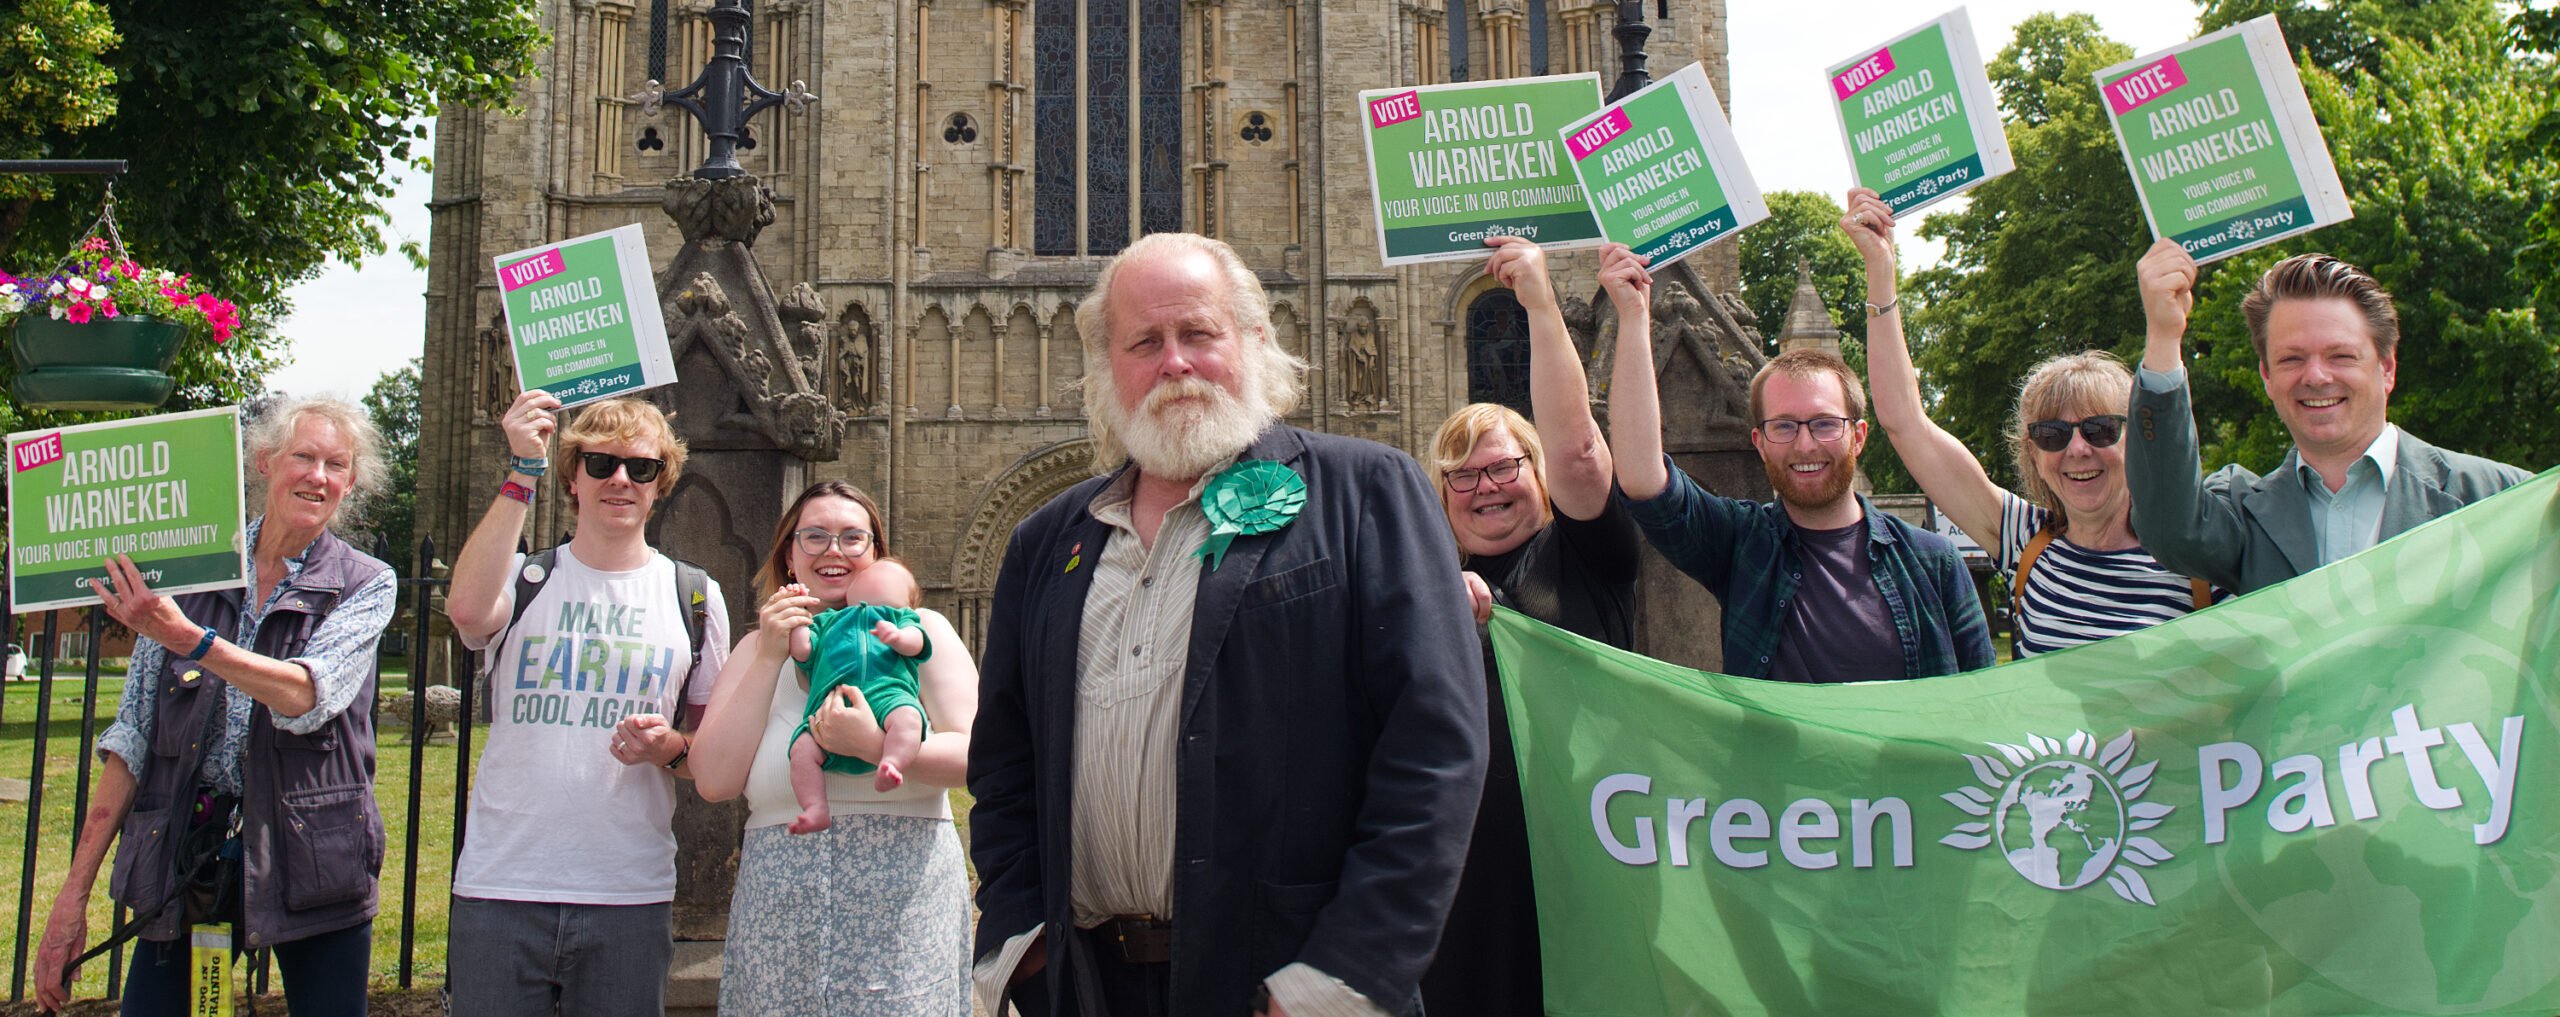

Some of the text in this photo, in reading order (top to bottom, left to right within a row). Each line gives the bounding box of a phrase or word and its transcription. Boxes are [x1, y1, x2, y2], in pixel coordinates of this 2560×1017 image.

[1841, 56, 1885, 92] VOTE
[2116, 65, 2172, 106] VOTE
[1373, 95, 1418, 123] VOTE
[1863, 69, 1934, 119] ARNOLD
[1423, 102, 1534, 144] ARNOLD
[1854, 92, 1958, 155] WARNEKEN
[2148, 87, 2240, 141] ARNOLD
[1575, 115, 1620, 153] VOTE
[1601, 125, 1675, 177] ARNOLD
[1884, 133, 1942, 166] YOUR VOICE IN
[2140, 118, 2274, 184] WARNEKEN
[1409, 139, 1558, 189] WARNEKEN
[1597, 147, 1702, 212] WARNEKEN
[1884, 146, 1950, 184] OUR COMMUNITY
[1937, 165, 1969, 187] Party
[1383, 183, 1582, 219] YOUR VOICE IN OUR COMMUNIT
[2182, 167, 2256, 200] YOUR VOICE IN
[1632, 187, 1690, 222] YOUR VOICE IN
[1633, 200, 1700, 239] OUR COMMUNITY
[2184, 184, 2269, 222] OUR COMMUNITY
[1449, 225, 1538, 243] Green Party
[1643, 244, 1668, 259] een
[1689, 218, 1721, 239] Party
[2182, 231, 2227, 253] Green
[2254, 209, 2294, 230] Party
[510, 255, 554, 285] VOTE
[530, 276, 602, 313] ARNOLD
[519, 302, 624, 346] WARNEKEN
[546, 352, 614, 378] OUR COMMUNITY
[547, 338, 606, 362] YOUR VOICE IN
[551, 387, 576, 399] een
[599, 373, 630, 388] Party
[17, 437, 60, 468] VOTE
[62, 440, 170, 487] ARNOLD
[46, 479, 188, 534] WARNEKEN
[17, 524, 218, 566] YOUR VOICE IN OUR COMMUNITY
[142, 568, 163, 582] arty
[558, 601, 646, 638] MAKE
[515, 636, 674, 698] EARTH
[512, 693, 573, 726] COOL
[1589, 703, 2524, 870] Green Party
[199, 966, 208, 1014] DOG IN
[209, 956, 220, 1017] RAINING
